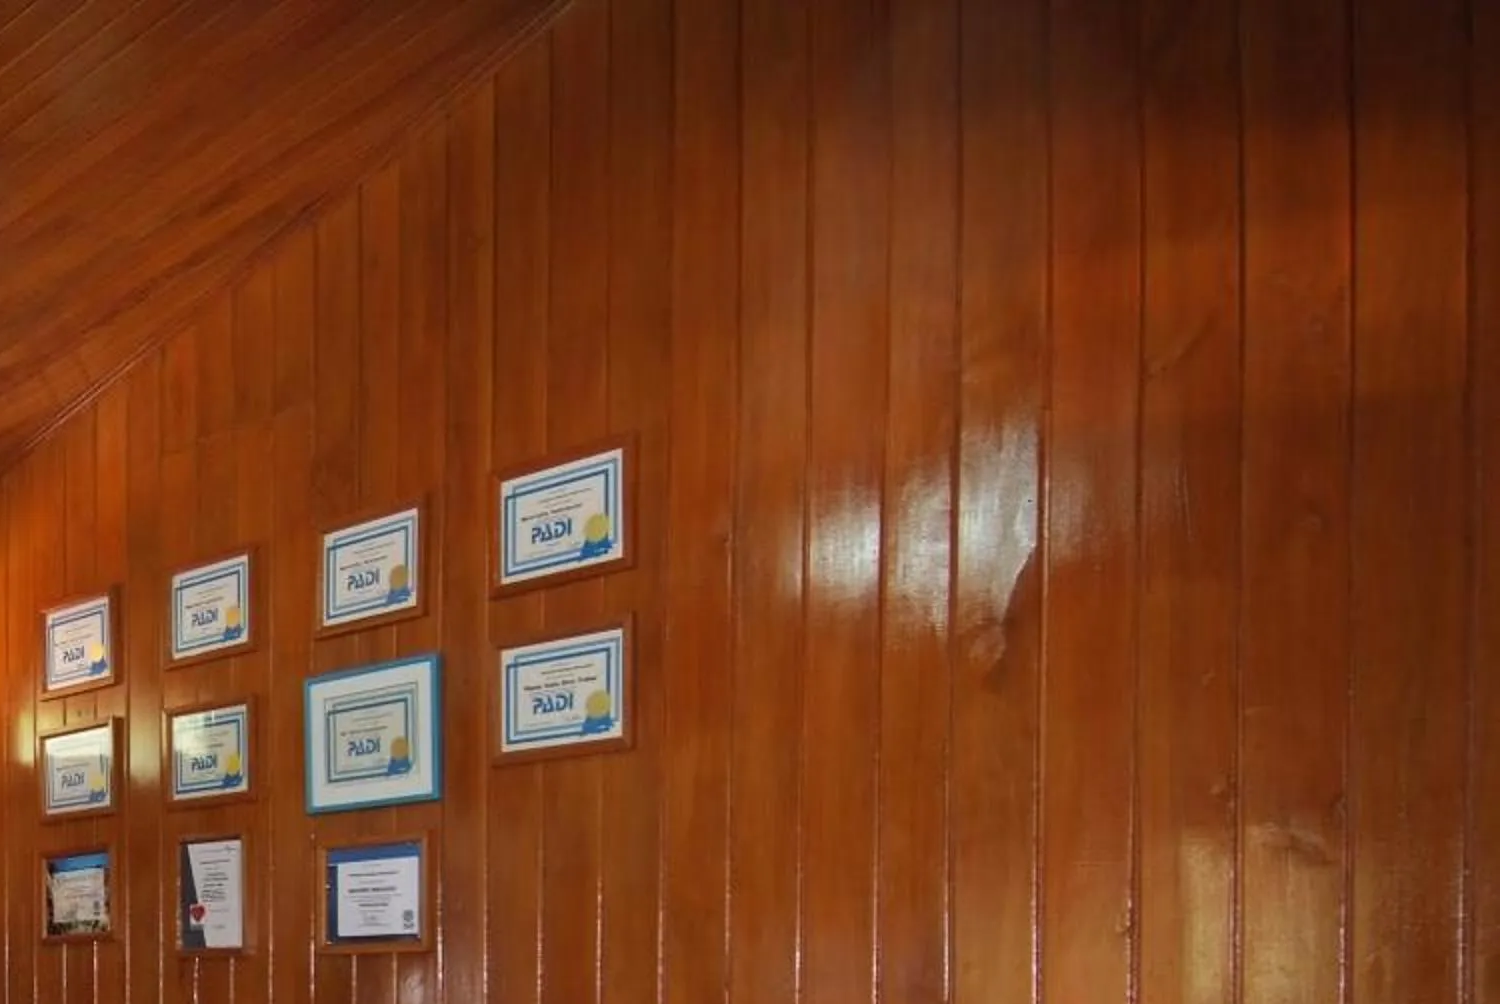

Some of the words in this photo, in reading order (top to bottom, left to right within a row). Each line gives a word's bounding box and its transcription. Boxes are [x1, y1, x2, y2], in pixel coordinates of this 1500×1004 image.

[531, 518, 572, 544] PADI
[347, 568, 380, 591] PADI
[532, 693, 573, 715] PADI
[347, 737, 380, 757] PADI
